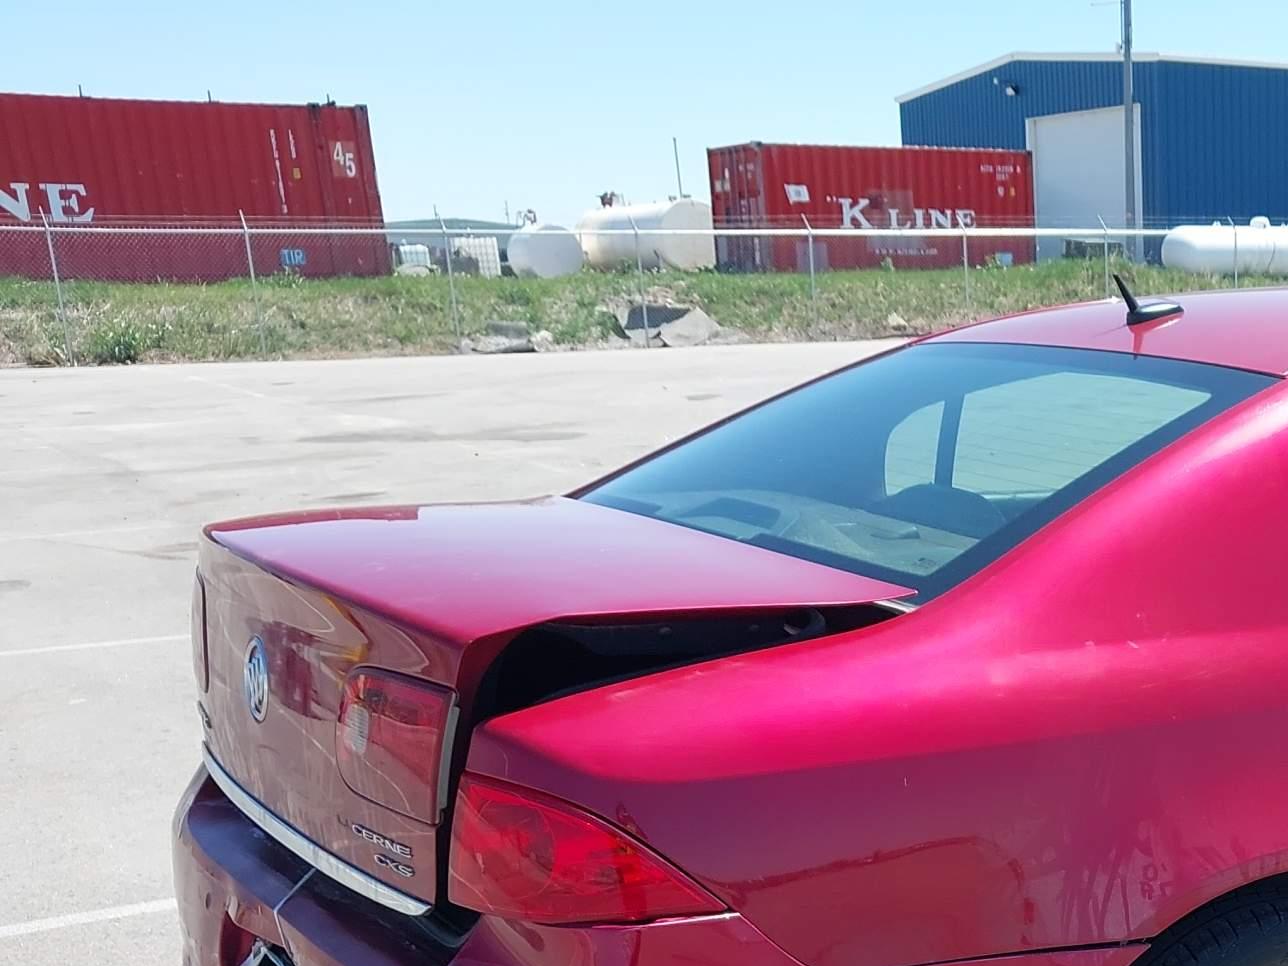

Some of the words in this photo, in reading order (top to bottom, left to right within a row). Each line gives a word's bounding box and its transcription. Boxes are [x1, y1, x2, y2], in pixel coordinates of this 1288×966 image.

[333, 141, 356, 178] 45
[888, 208, 977, 229] LINE
[281, 249, 304, 265] TIR
[374, 853, 415, 878] CXS
